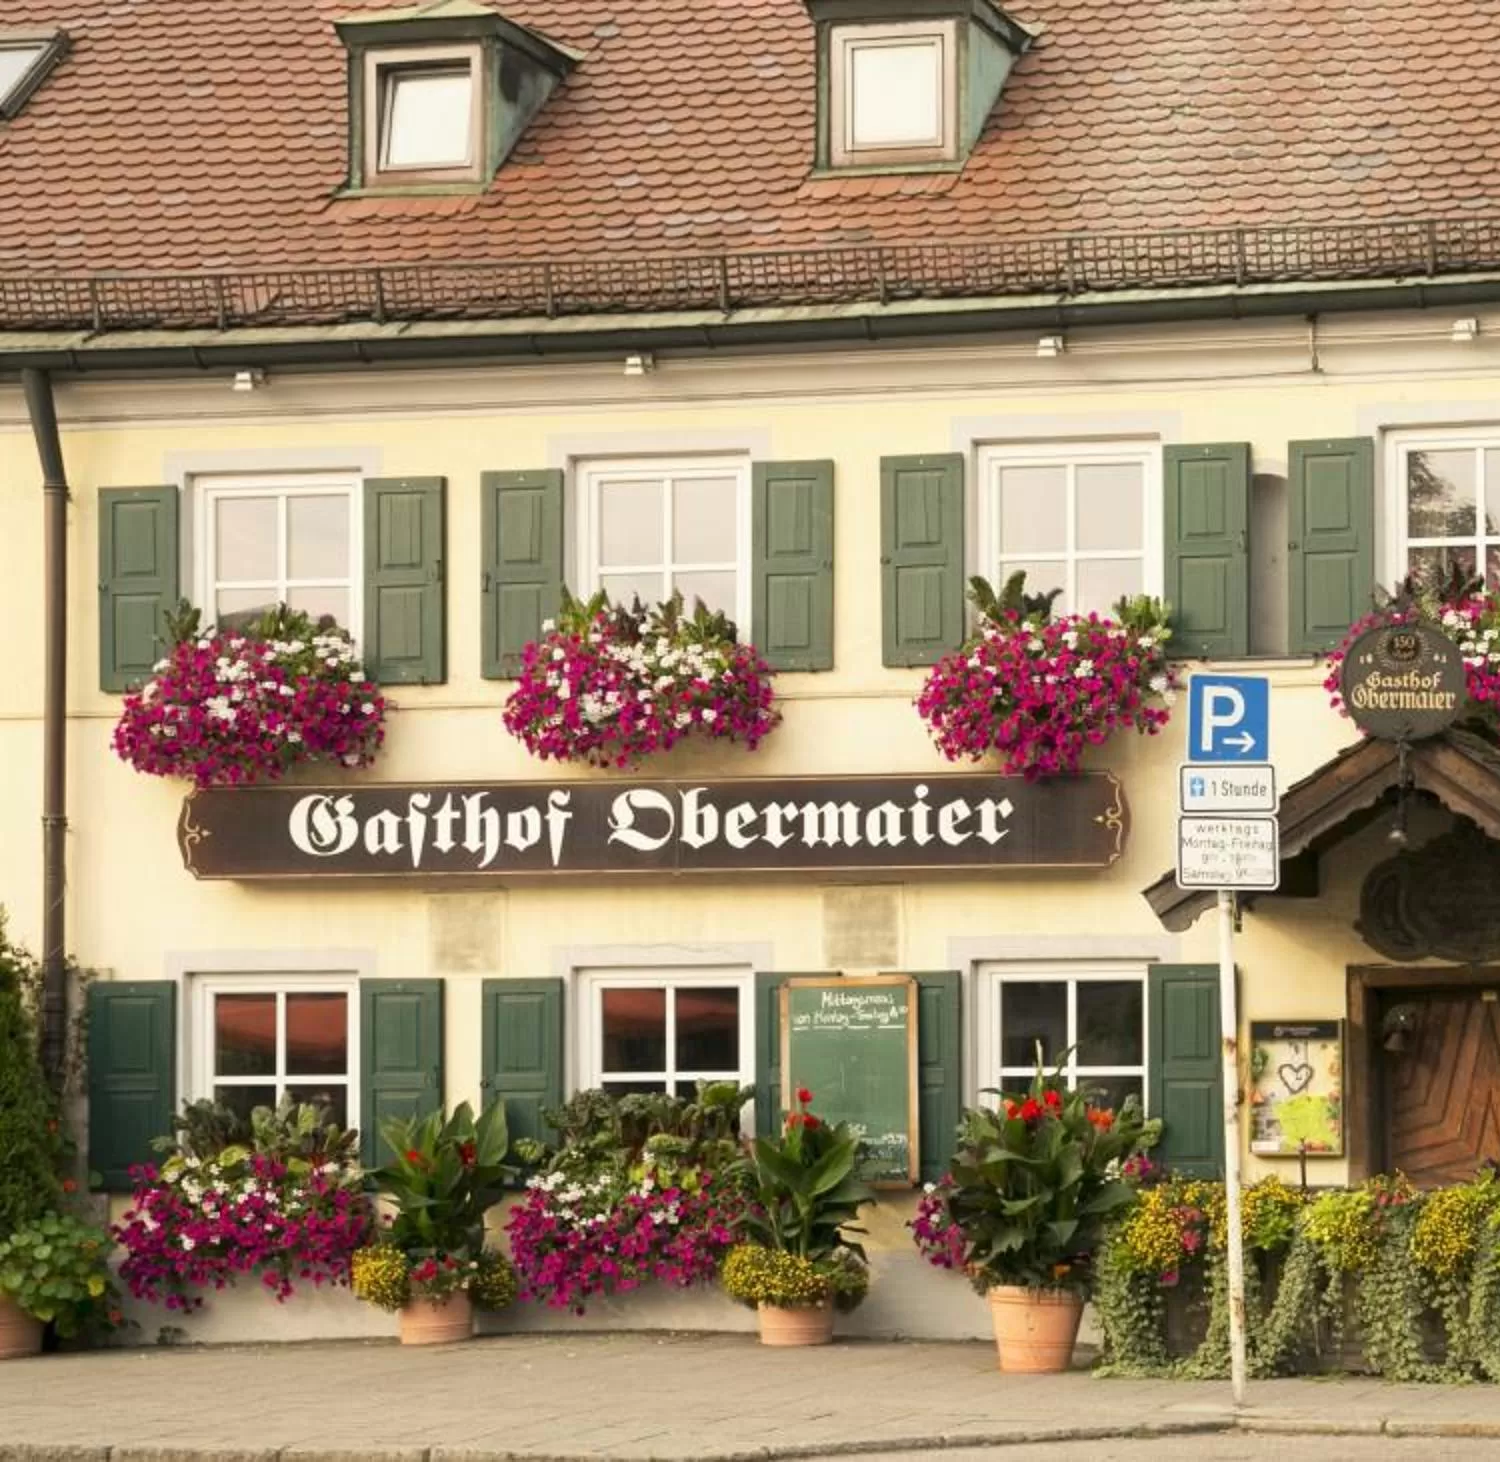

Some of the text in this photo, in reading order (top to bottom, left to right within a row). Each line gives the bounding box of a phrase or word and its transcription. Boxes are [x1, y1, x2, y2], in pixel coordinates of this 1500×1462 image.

[1365, 670, 1443, 689] Gasthof
[1351, 683, 1456, 709] Obermaier
[1201, 685, 1245, 751] P
[1211, 779, 1267, 797] 1 Stunde
[607, 783, 1014, 852] Obermaier
